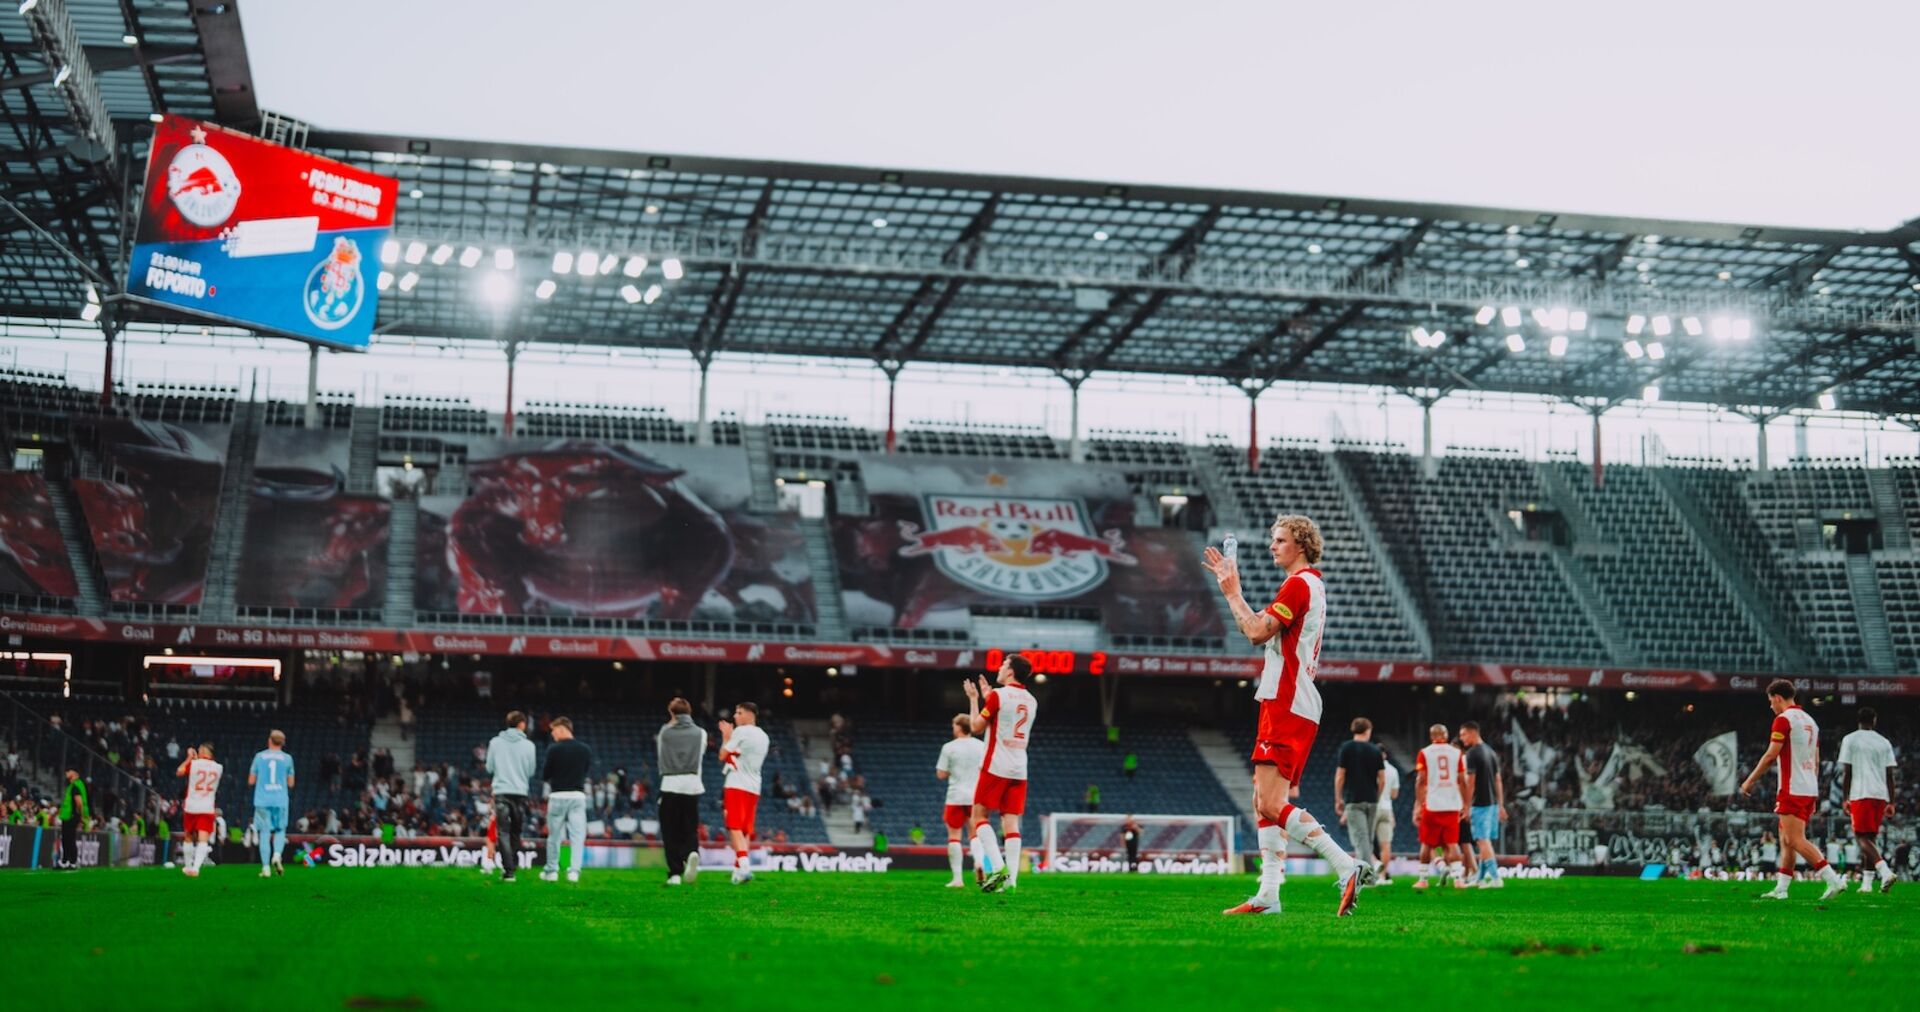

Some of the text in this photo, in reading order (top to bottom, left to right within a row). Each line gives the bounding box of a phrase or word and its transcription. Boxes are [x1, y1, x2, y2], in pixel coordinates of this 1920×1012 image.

[146, 265, 207, 299] FC PORTO
[936, 500, 1076, 521] Red Bull
[956, 554, 1092, 591] SALZBURG
[0, 616, 57, 635] Gewinner
[121, 624, 154, 640] Goal
[216, 629, 239, 643] Die
[266, 630, 293, 645] hier
[298, 632, 315, 645] im
[905, 650, 938, 665] Goal
[1089, 652, 1107, 675] 2
[1621, 672, 1678, 687] Gewinner
[1730, 676, 1757, 690] Goal
[1013, 703, 1028, 739] 2
[1803, 724, 1813, 747] 7
[268, 759, 277, 784] 1
[1437, 754, 1450, 781] 9
[195, 769, 218, 792] 22
[800, 851, 893, 872] Verkehr
[1497, 862, 1565, 879] erkehr
